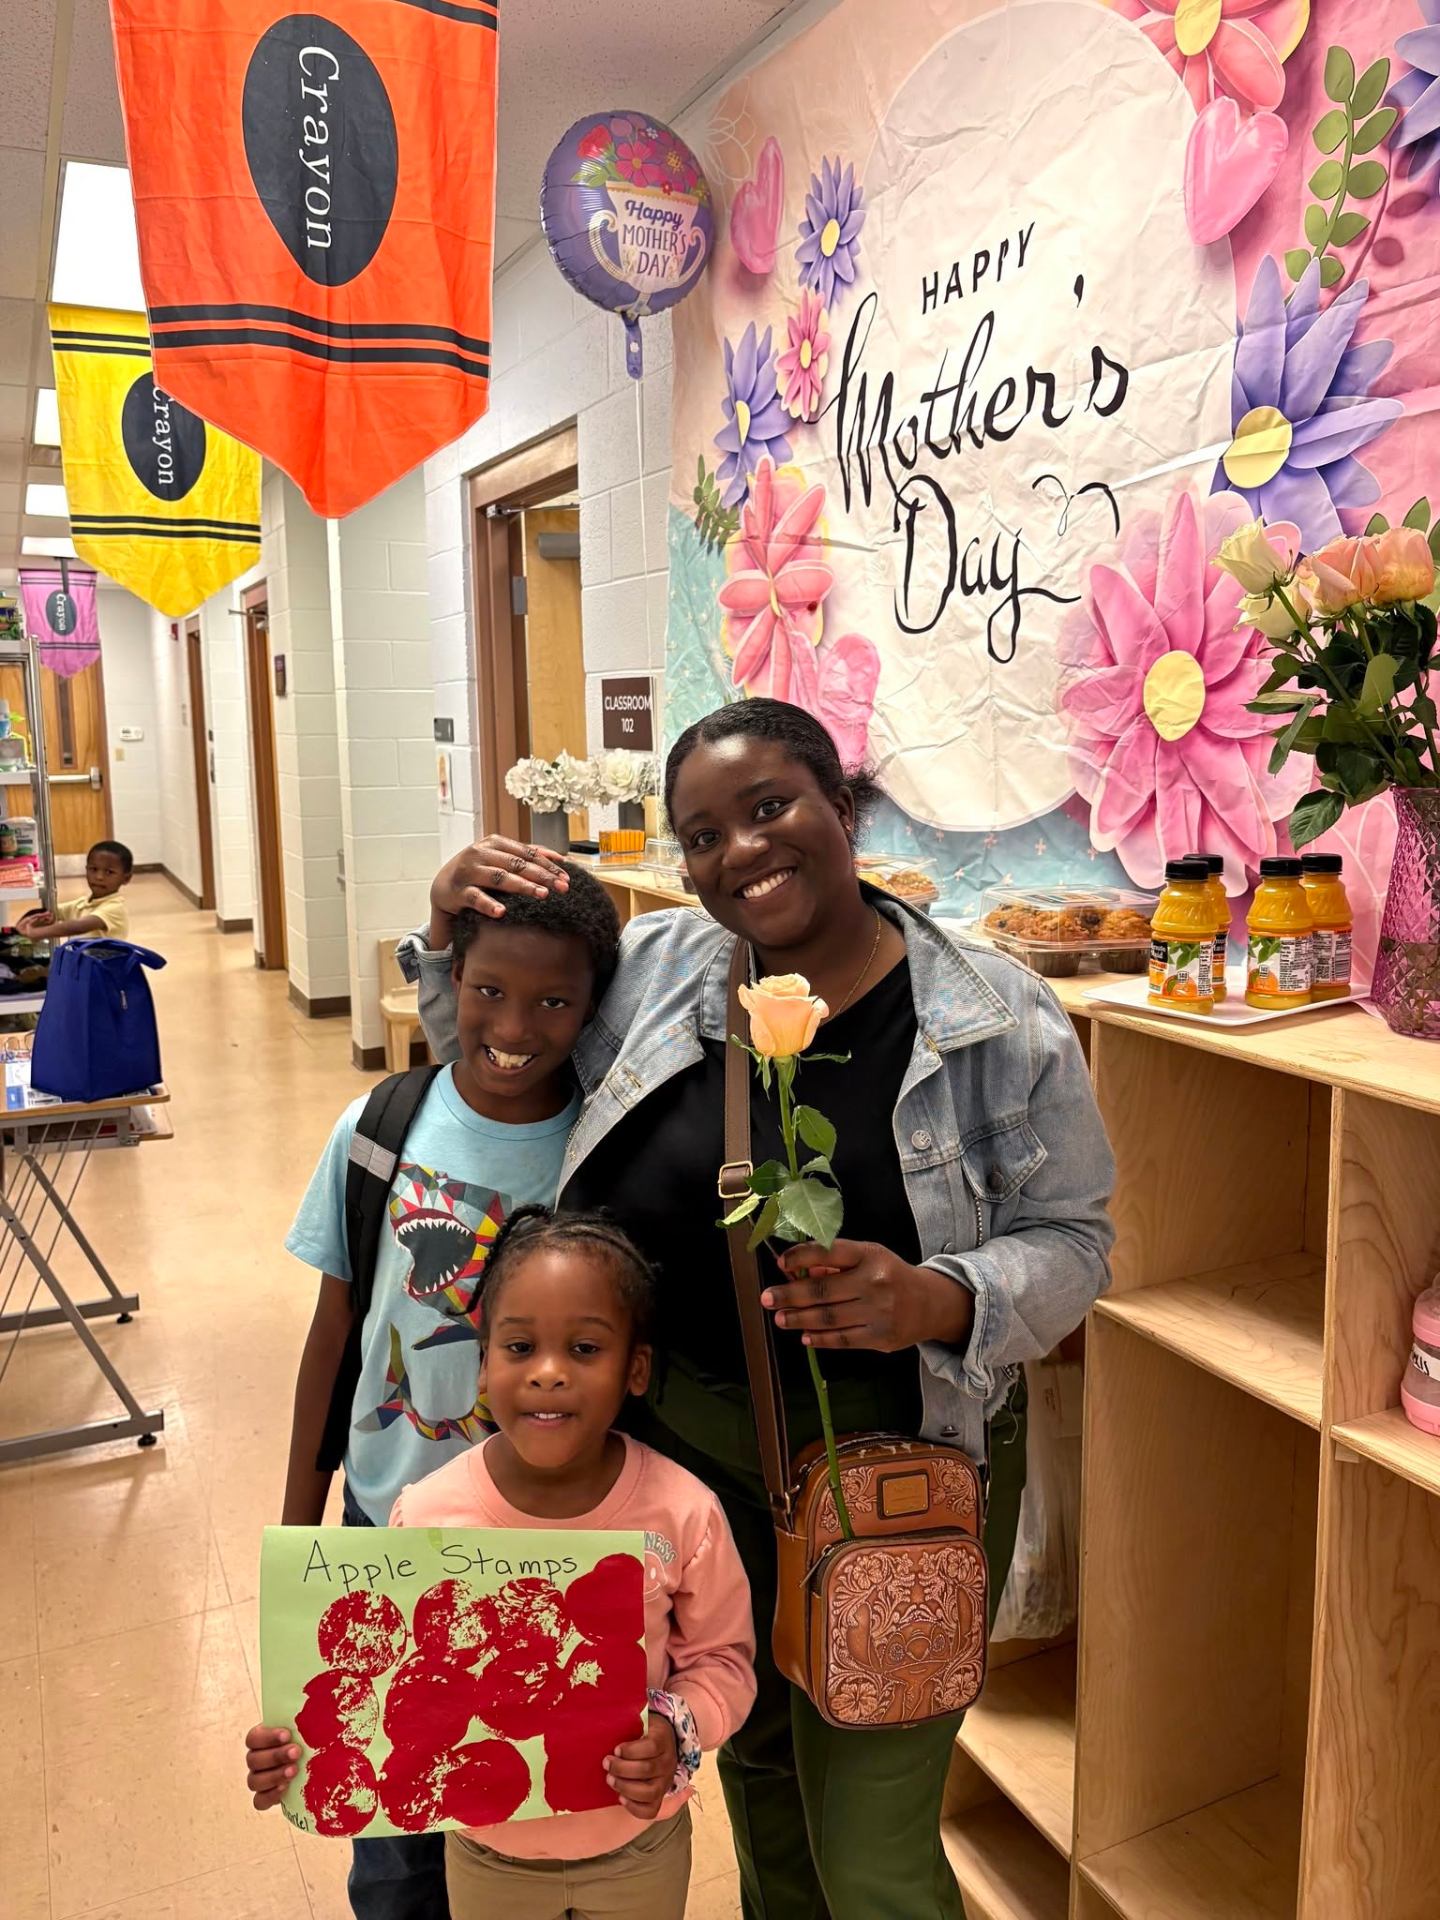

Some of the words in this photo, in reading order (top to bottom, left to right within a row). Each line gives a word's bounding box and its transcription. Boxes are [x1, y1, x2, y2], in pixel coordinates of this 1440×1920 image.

[298, 46, 340, 249] Crayon
[625, 199, 684, 232] Happy
[622, 224, 687, 256] MOTHER'S
[637, 251, 670, 278] DAY
[922, 222, 1035, 315] HAPPY
[812, 274, 1130, 514] Mother's
[893, 474, 1082, 664] Day
[604, 694, 652, 711] CLASSROOM
[621, 717, 635, 733] 102
[303, 1539, 418, 1594] Apple
[440, 1544, 578, 1585] Stamps
